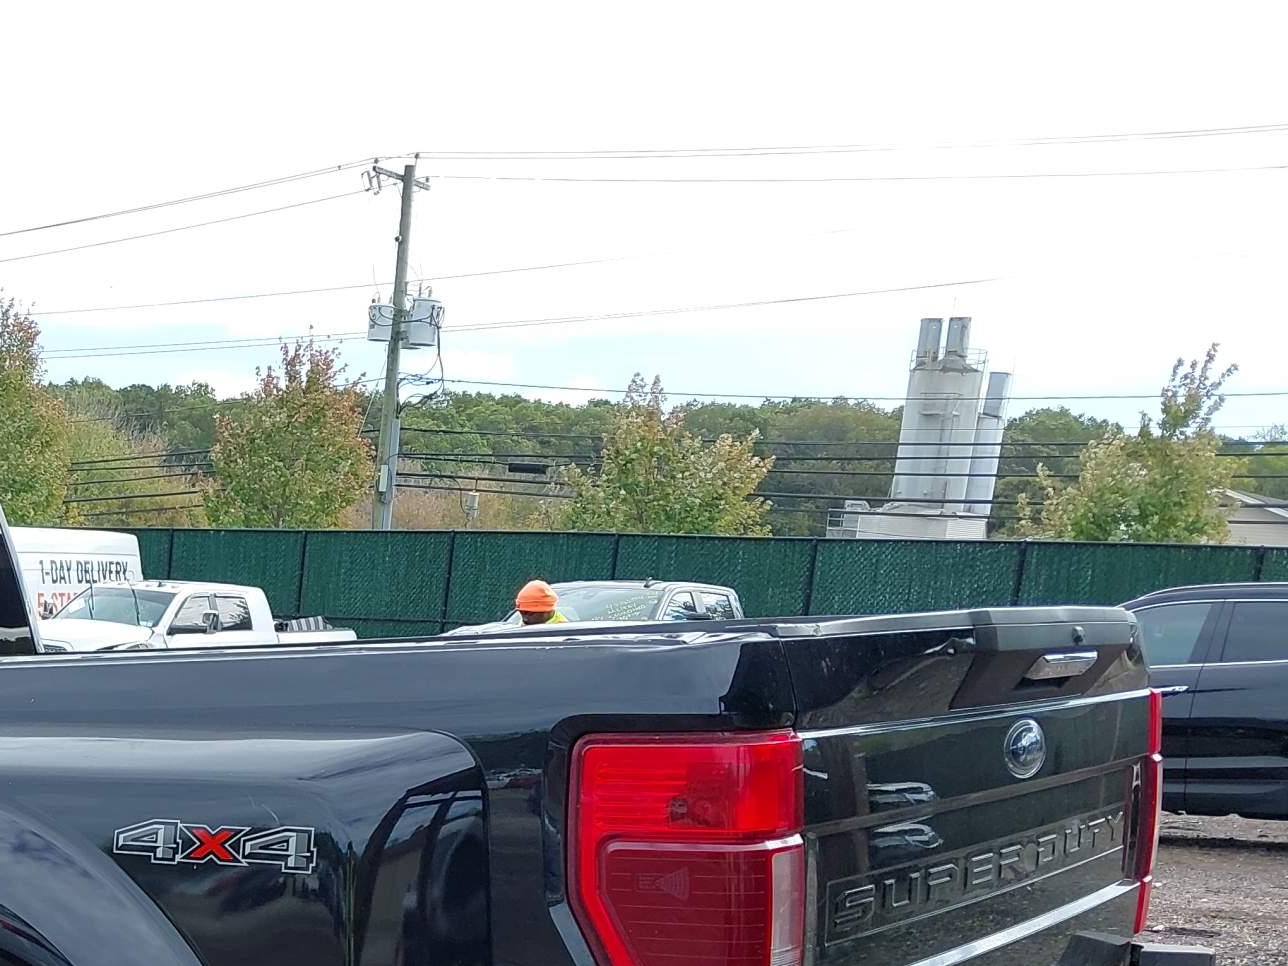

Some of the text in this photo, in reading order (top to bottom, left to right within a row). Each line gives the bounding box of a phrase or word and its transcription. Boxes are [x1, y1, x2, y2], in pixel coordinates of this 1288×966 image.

[39, 560, 128, 584] 1-DAY DELIVERY
[833, 811, 1124, 931] SUPER DUTY
